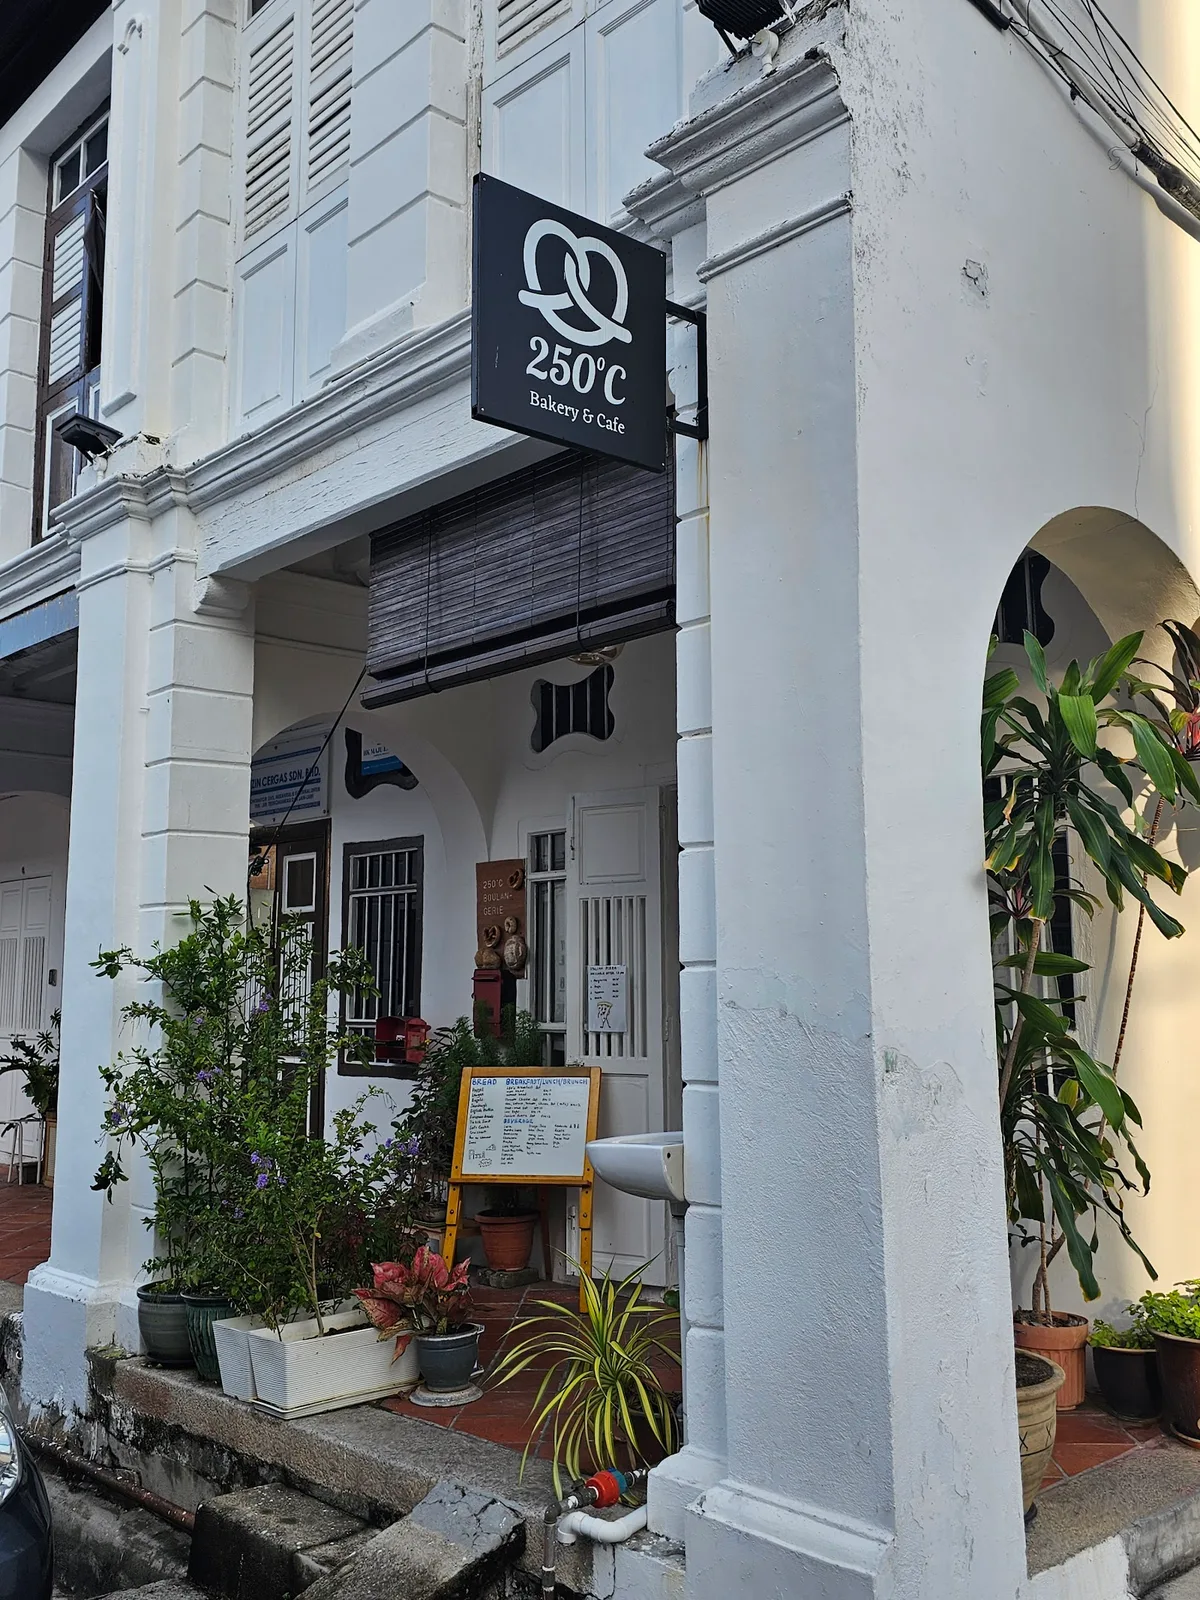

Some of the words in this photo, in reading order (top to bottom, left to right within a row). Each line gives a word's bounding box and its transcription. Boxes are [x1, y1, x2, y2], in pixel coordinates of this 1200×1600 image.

[529, 390, 579, 422] Bakery
[582, 408, 595, 424] &
[596, 413, 626, 435] Cafe
[262, 772, 288, 786] CERGAS
[289, 769, 304, 782] SDN.
[483, 905, 504, 916] GERIE
[471, 1078, 497, 1086] BREAD
